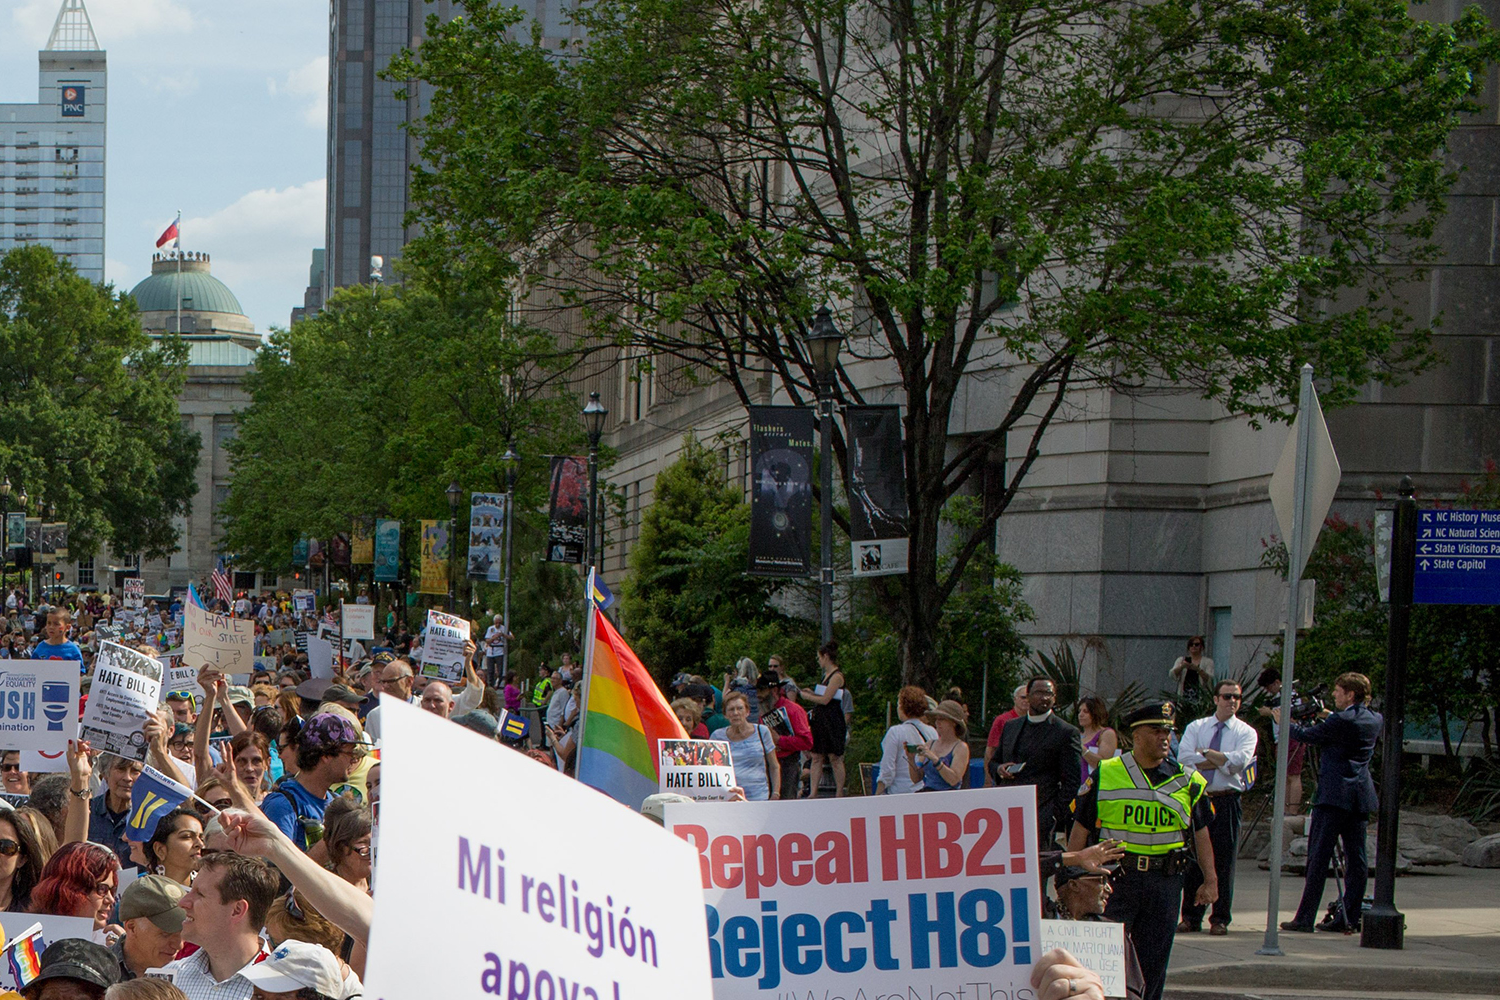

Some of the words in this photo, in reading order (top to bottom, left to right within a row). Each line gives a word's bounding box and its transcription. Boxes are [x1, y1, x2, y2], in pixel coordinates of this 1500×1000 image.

[1436, 512, 1448, 521] NC
[1450, 512, 1479, 524] History
[1481, 512, 1500, 522] Muse
[1435, 528, 1447, 538] NC
[1448, 528, 1478, 538] Natural
[1434, 543, 1456, 553] State
[1458, 543, 1488, 554] Visitors
[1433, 559, 1455, 569] State
[1456, 559, 1486, 571] Capitol
[125, 592, 143, 600] KNOW
[204, 612, 244, 632] HATE
[199, 627, 213, 638] OUR
[218, 632, 249, 644] STATE
[429, 626, 446, 637] HATE
[447, 629, 462, 639] BILL
[175, 670, 189, 680] BILL
[190, 668, 195, 677] 2
[5, 680, 36, 688] EQUALITY
[98, 669, 124, 687] HATE
[126, 677, 146, 695] BILL
[149, 686, 156, 698] 2
[666, 772, 693, 788] HATE
[698, 772, 722, 788] BILL
[724, 773, 732, 787] 2
[1123, 804, 1176, 827] POLICE
[878, 806, 1027, 882] HB2!
[457, 835, 506, 904] Mi
[521, 873, 659, 968] religión
[907, 887, 1032, 970] H8!
[1047, 925, 1054, 936] A
[1057, 925, 1081, 937] CIVIL
[1083, 926, 1115, 939] RIGHT
[1099, 959, 1118, 972] USE
